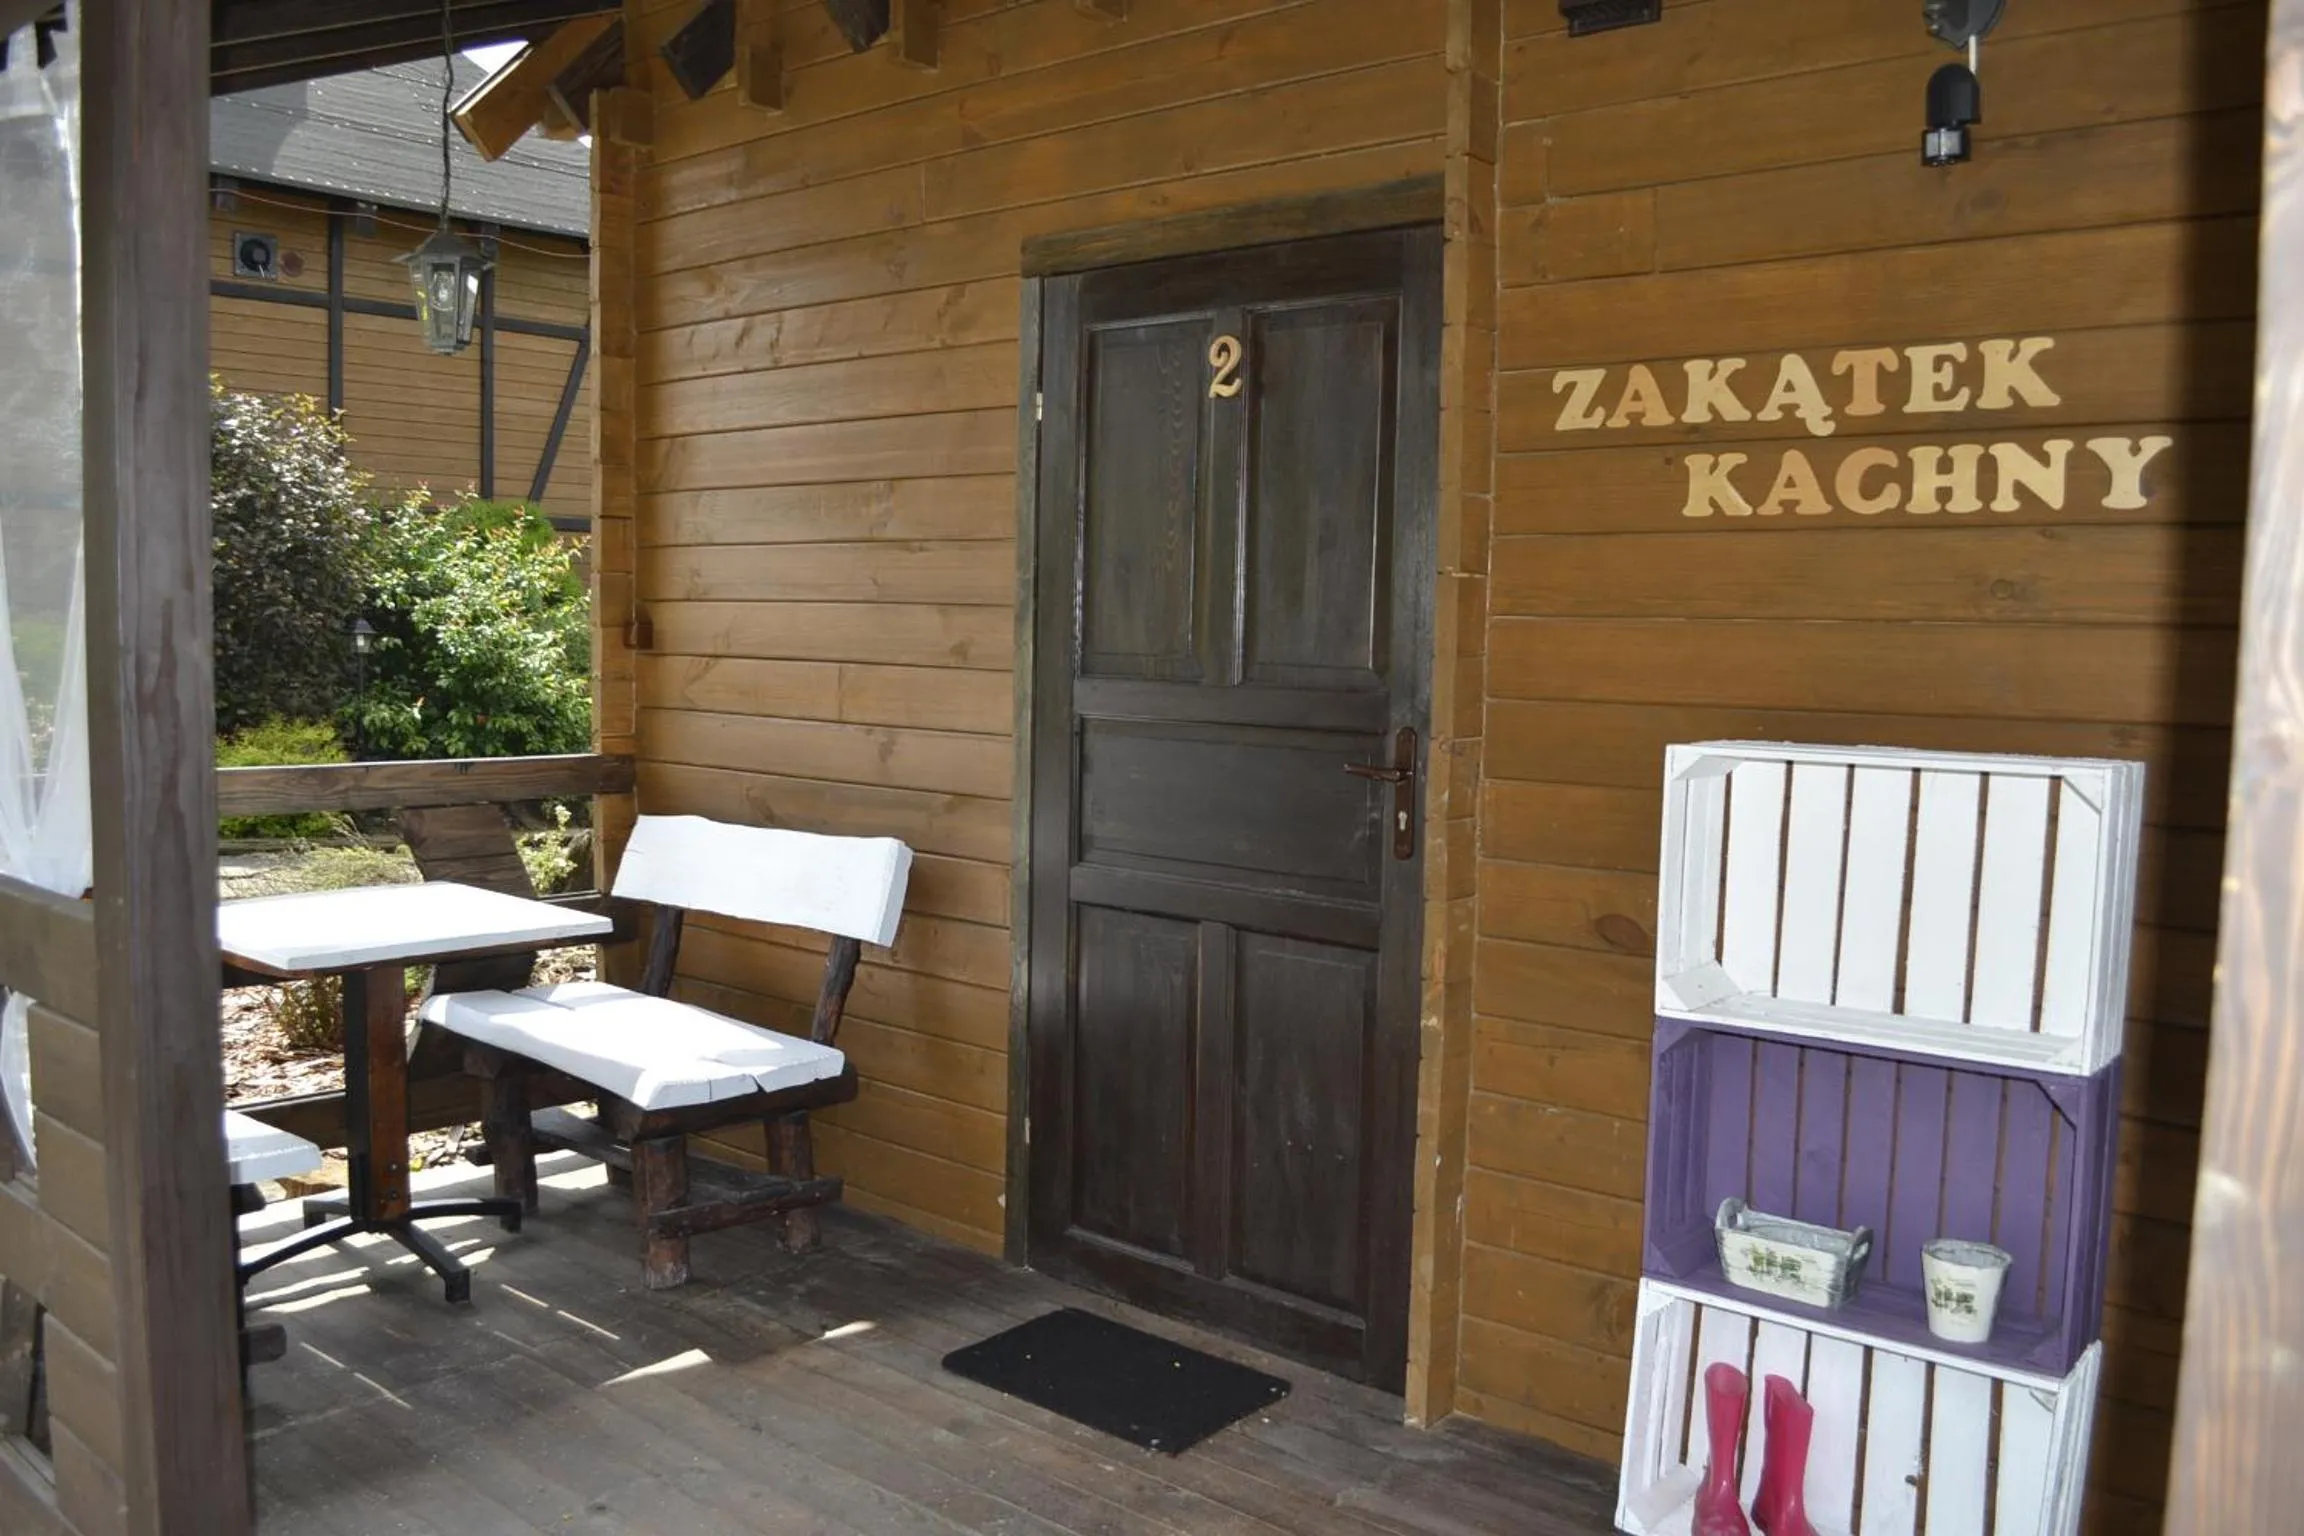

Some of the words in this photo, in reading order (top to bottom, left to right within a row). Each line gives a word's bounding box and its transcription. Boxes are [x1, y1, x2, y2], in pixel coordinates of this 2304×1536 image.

[1208, 335, 1242, 398] 2
[1552, 337, 2062, 436] ZAKĄTEK
[1681, 435, 2174, 517] KACHNY
